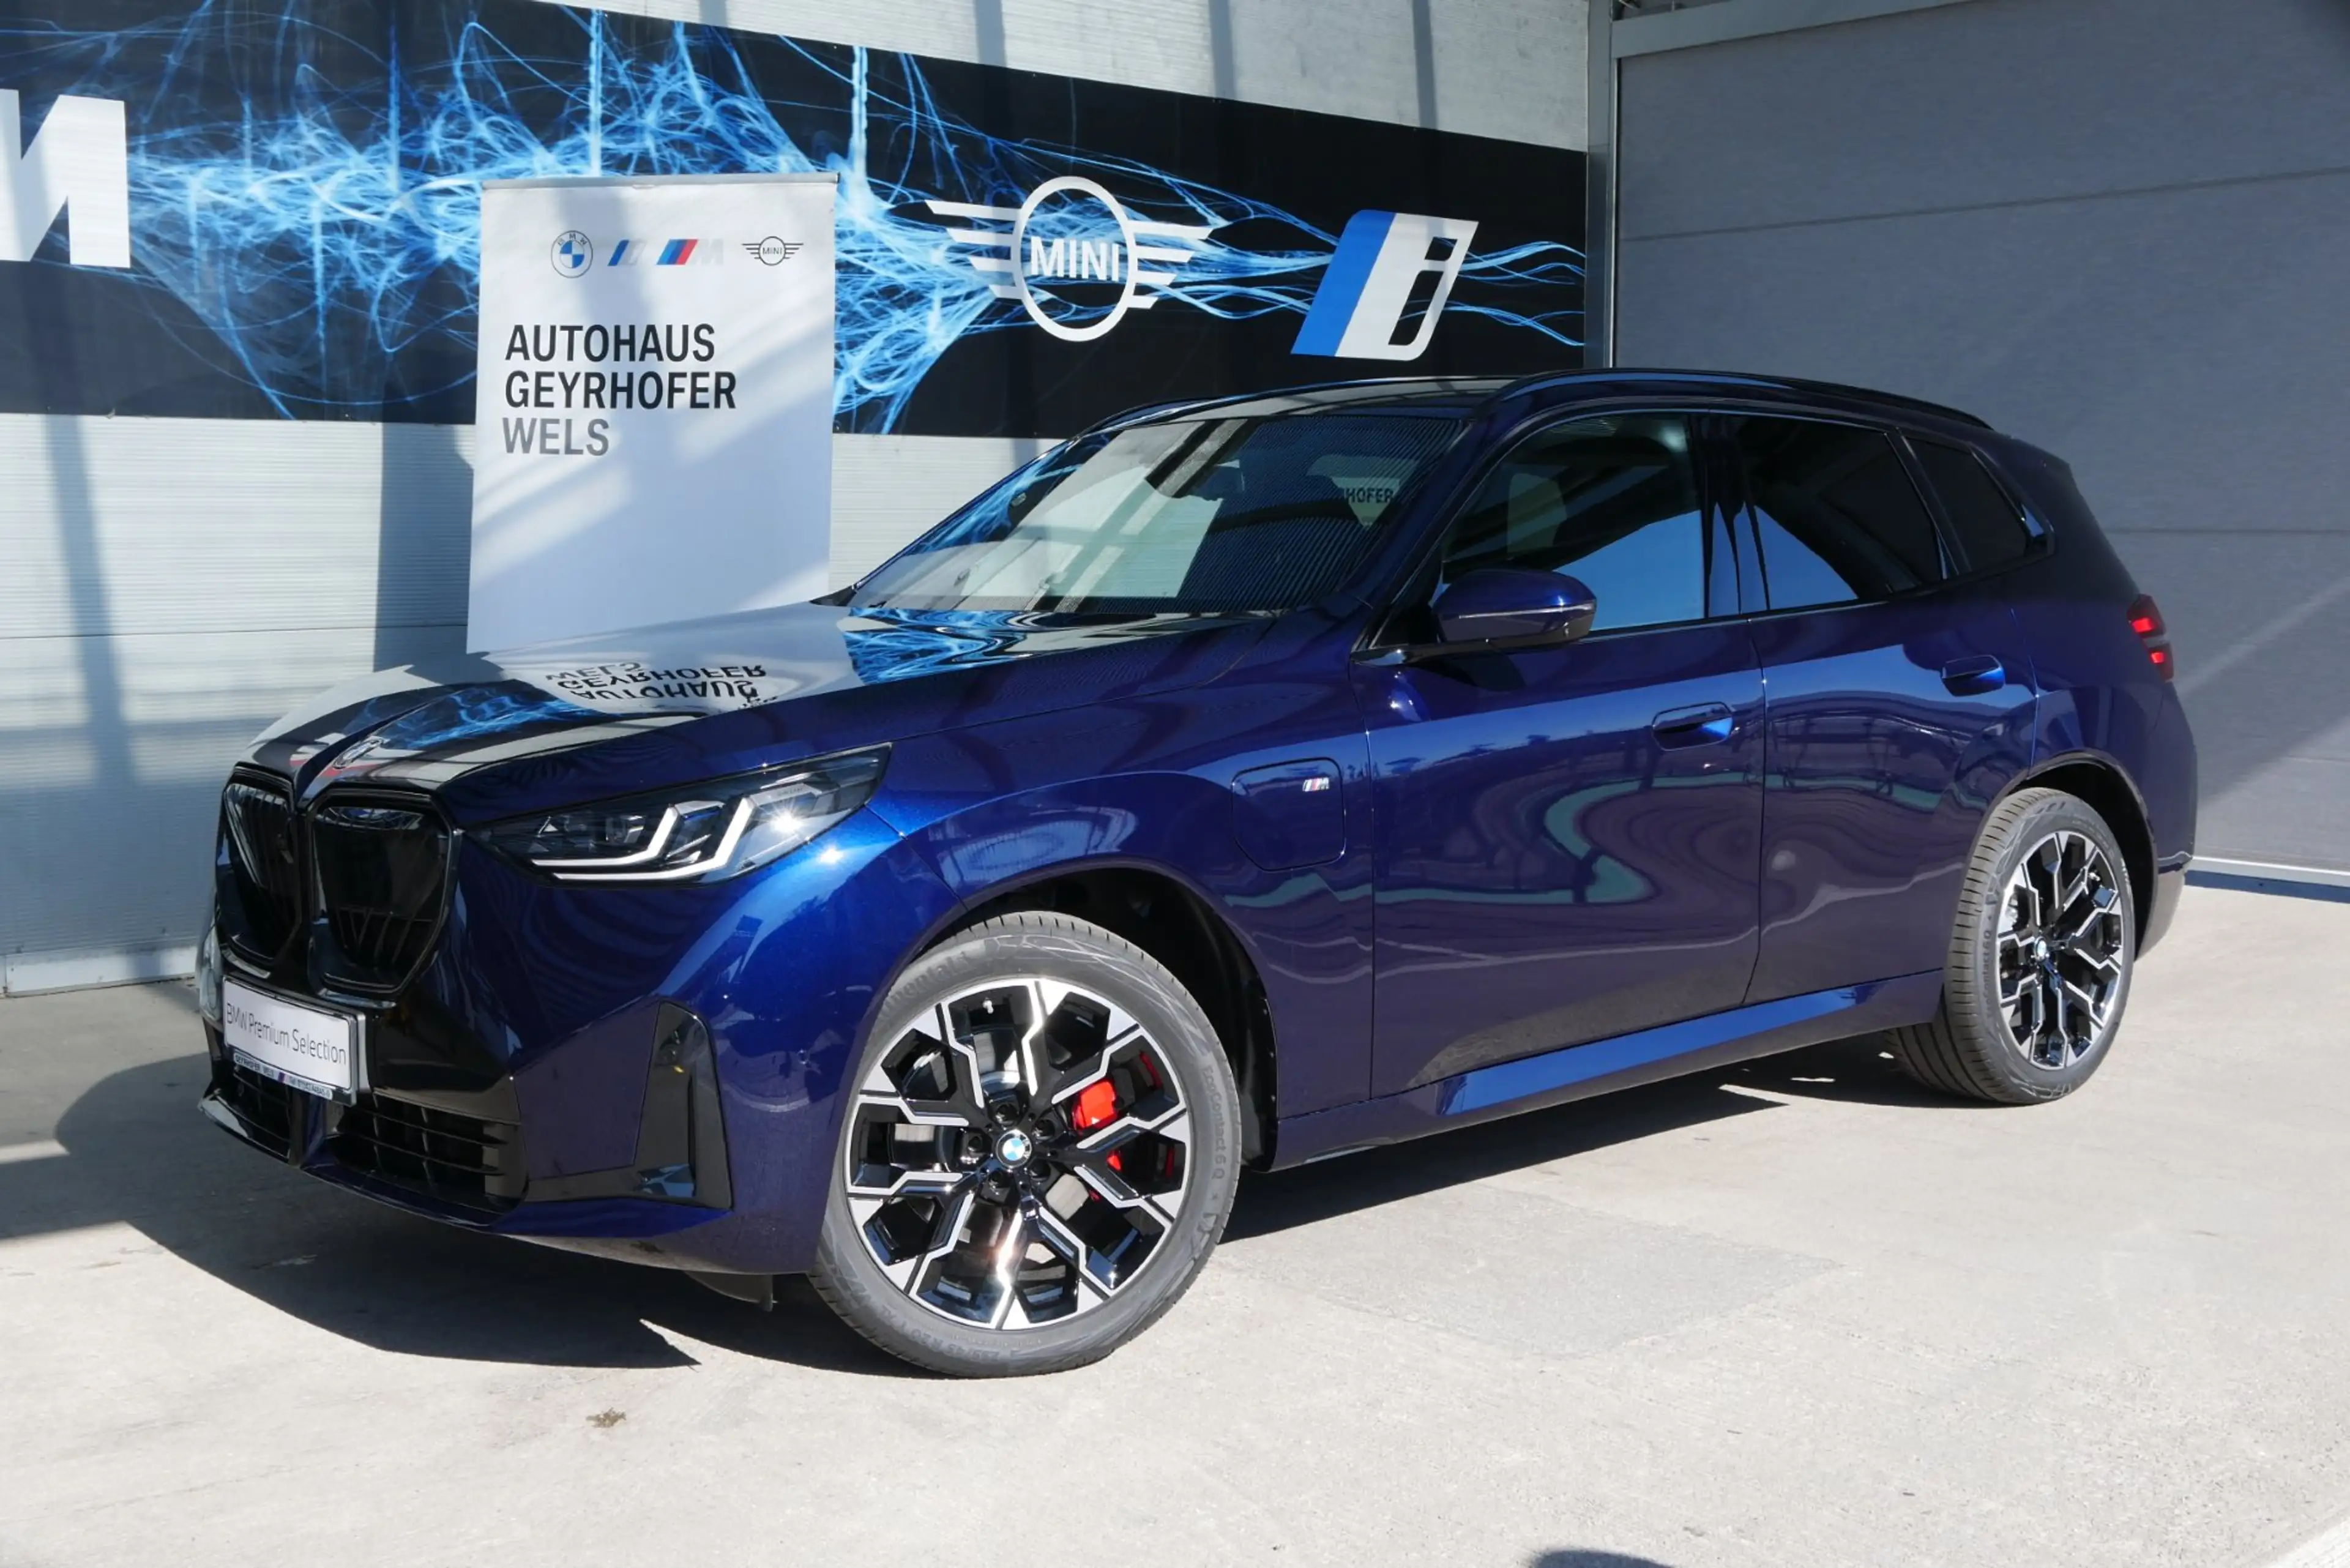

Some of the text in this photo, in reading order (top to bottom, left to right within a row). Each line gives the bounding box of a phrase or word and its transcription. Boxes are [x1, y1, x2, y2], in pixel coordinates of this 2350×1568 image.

[763, 247, 783, 255] MINI
[1031, 236, 1119, 282] MINI
[505, 323, 715, 362] AUTOHAUS
[505, 370, 737, 409] GEYRHOFER
[502, 417, 610, 457] WELS
[226, 1003, 346, 1065] BMW Premium Selection
